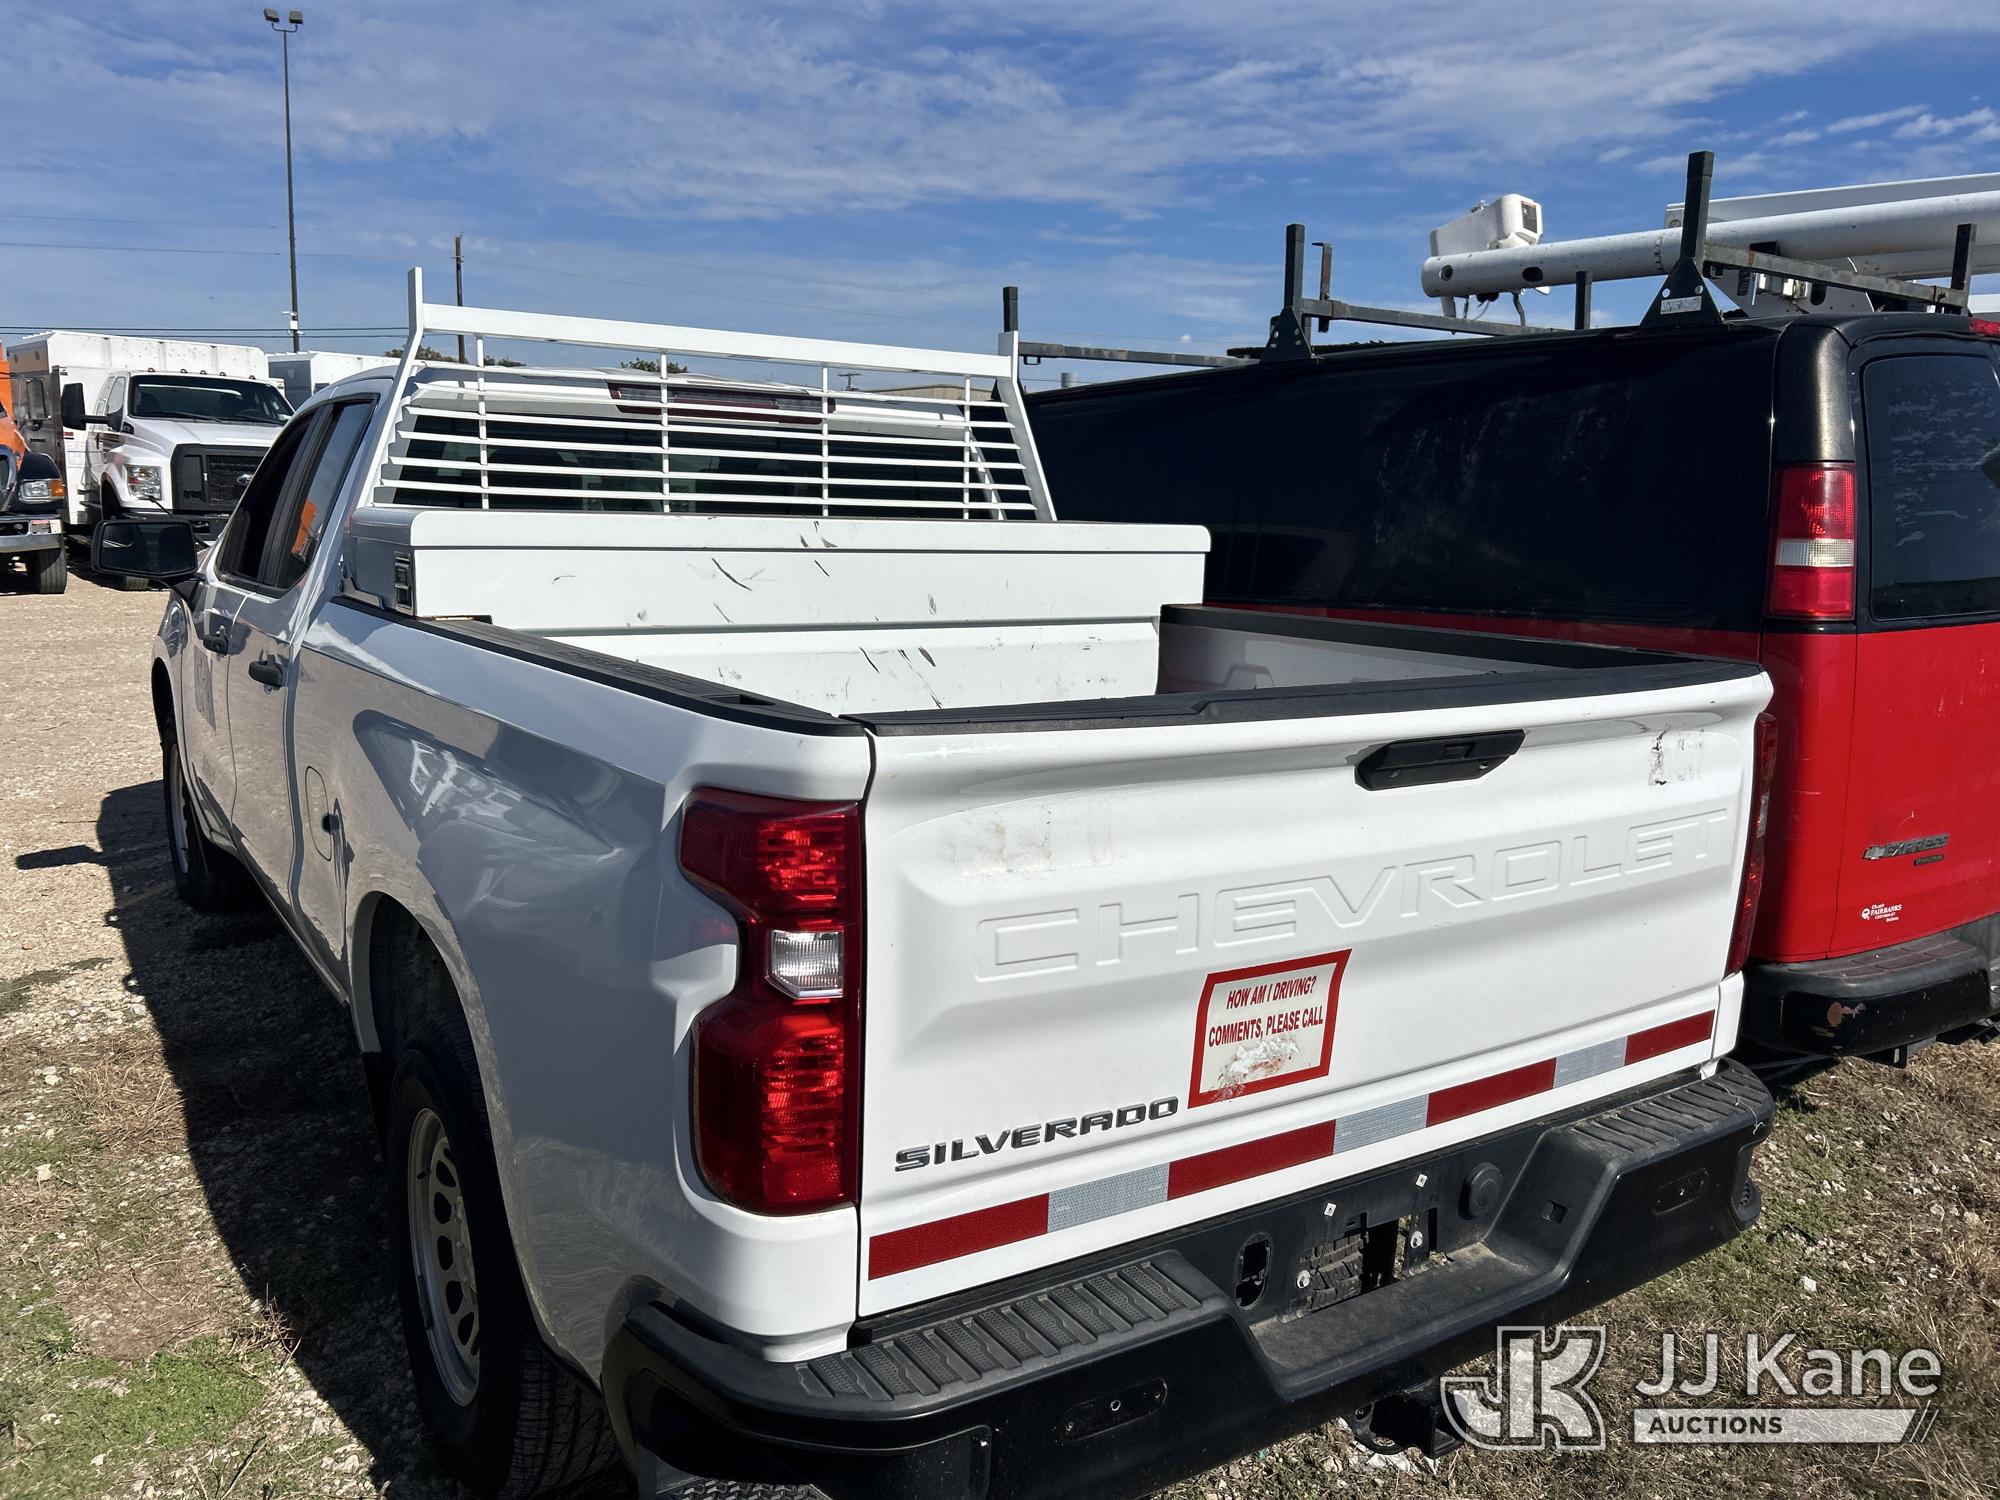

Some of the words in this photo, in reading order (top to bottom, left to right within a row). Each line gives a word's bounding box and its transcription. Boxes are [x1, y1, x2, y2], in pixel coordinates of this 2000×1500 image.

[974, 808, 1728, 983] CHEVROLET
[1226, 987, 1251, 1010] HOW
[1250, 984, 1267, 1006] AM
[1267, 982, 1273, 1002] I
[1272, 975, 1318, 1002] DRIVING?
[1208, 1017, 1263, 1048] COMMENTS,
[1266, 1010, 1301, 1036] PLEASE
[1302, 1005, 1324, 1028] CALL
[895, 1096, 1179, 1172] SILVERADO
